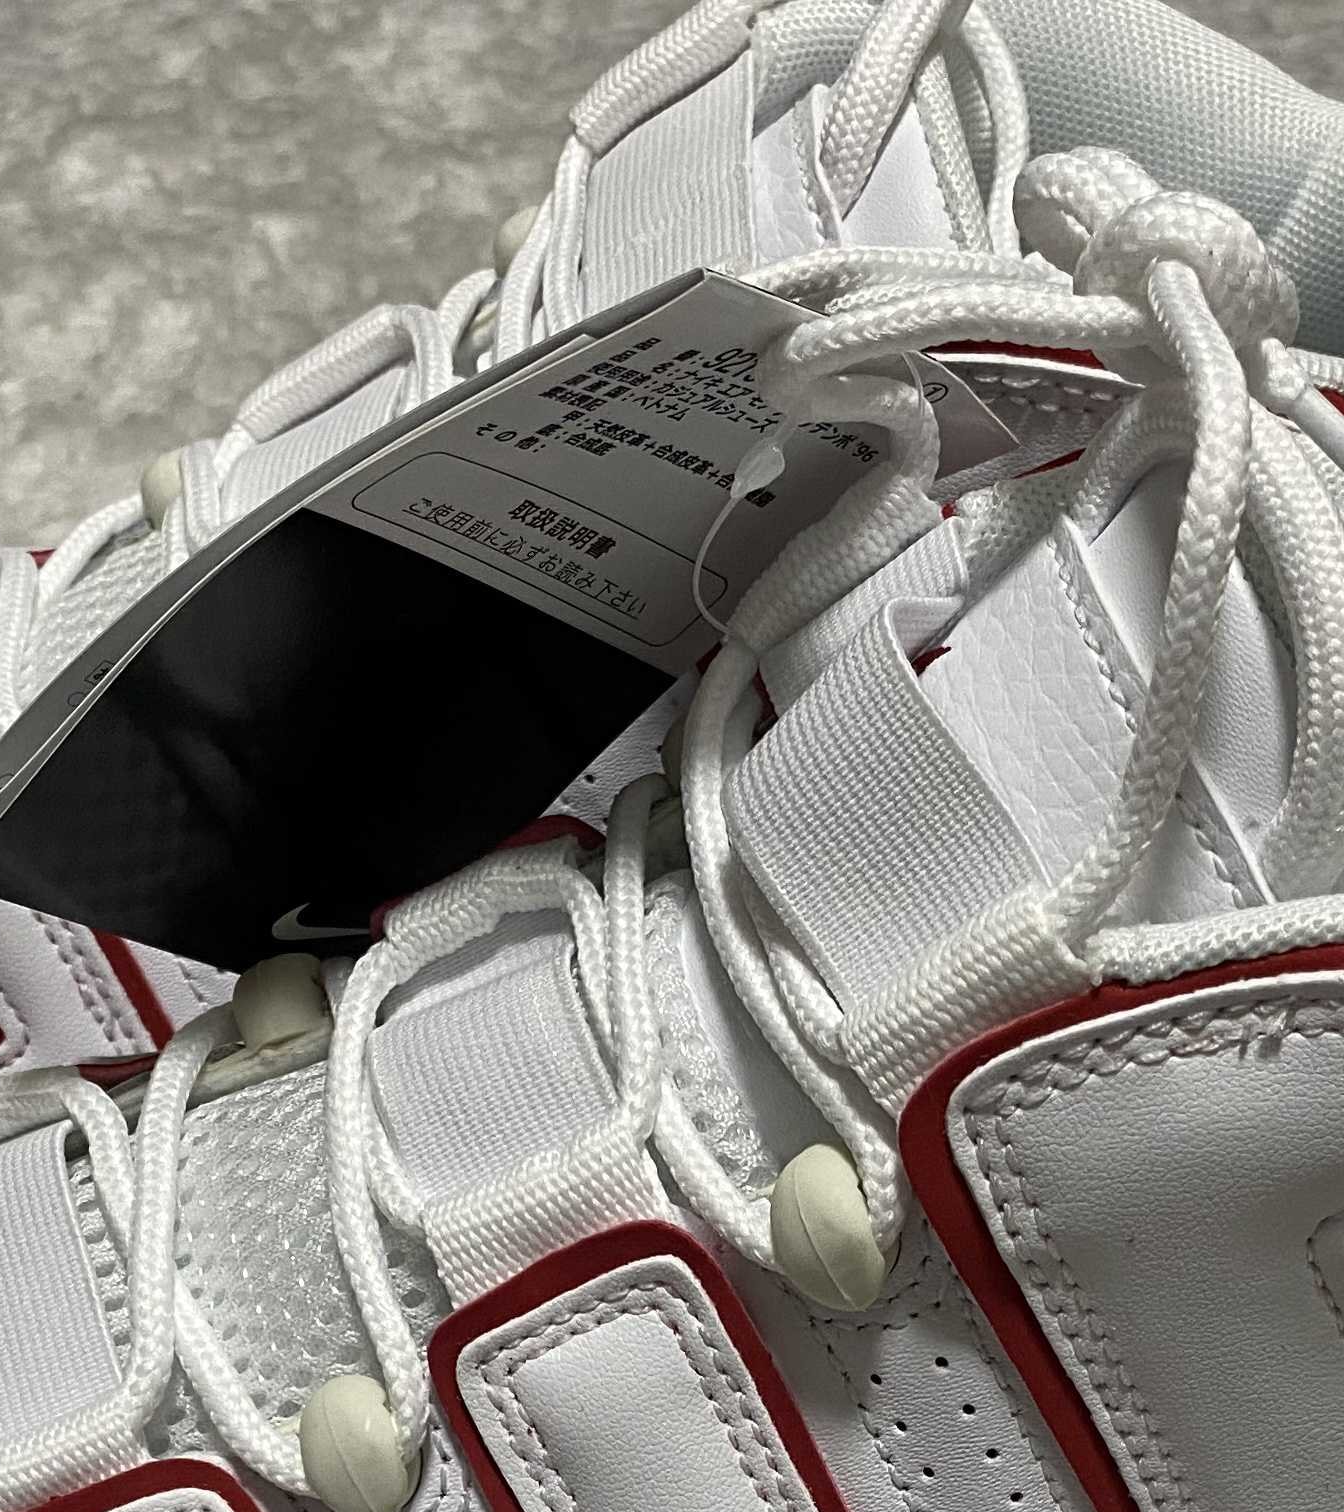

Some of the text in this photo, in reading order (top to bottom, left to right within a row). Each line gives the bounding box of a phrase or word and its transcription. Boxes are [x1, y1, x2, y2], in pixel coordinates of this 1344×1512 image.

[408, 497, 647, 615] ご使用前に必ずお読み下さい
[508, 499, 616, 559] 取扱説明書
